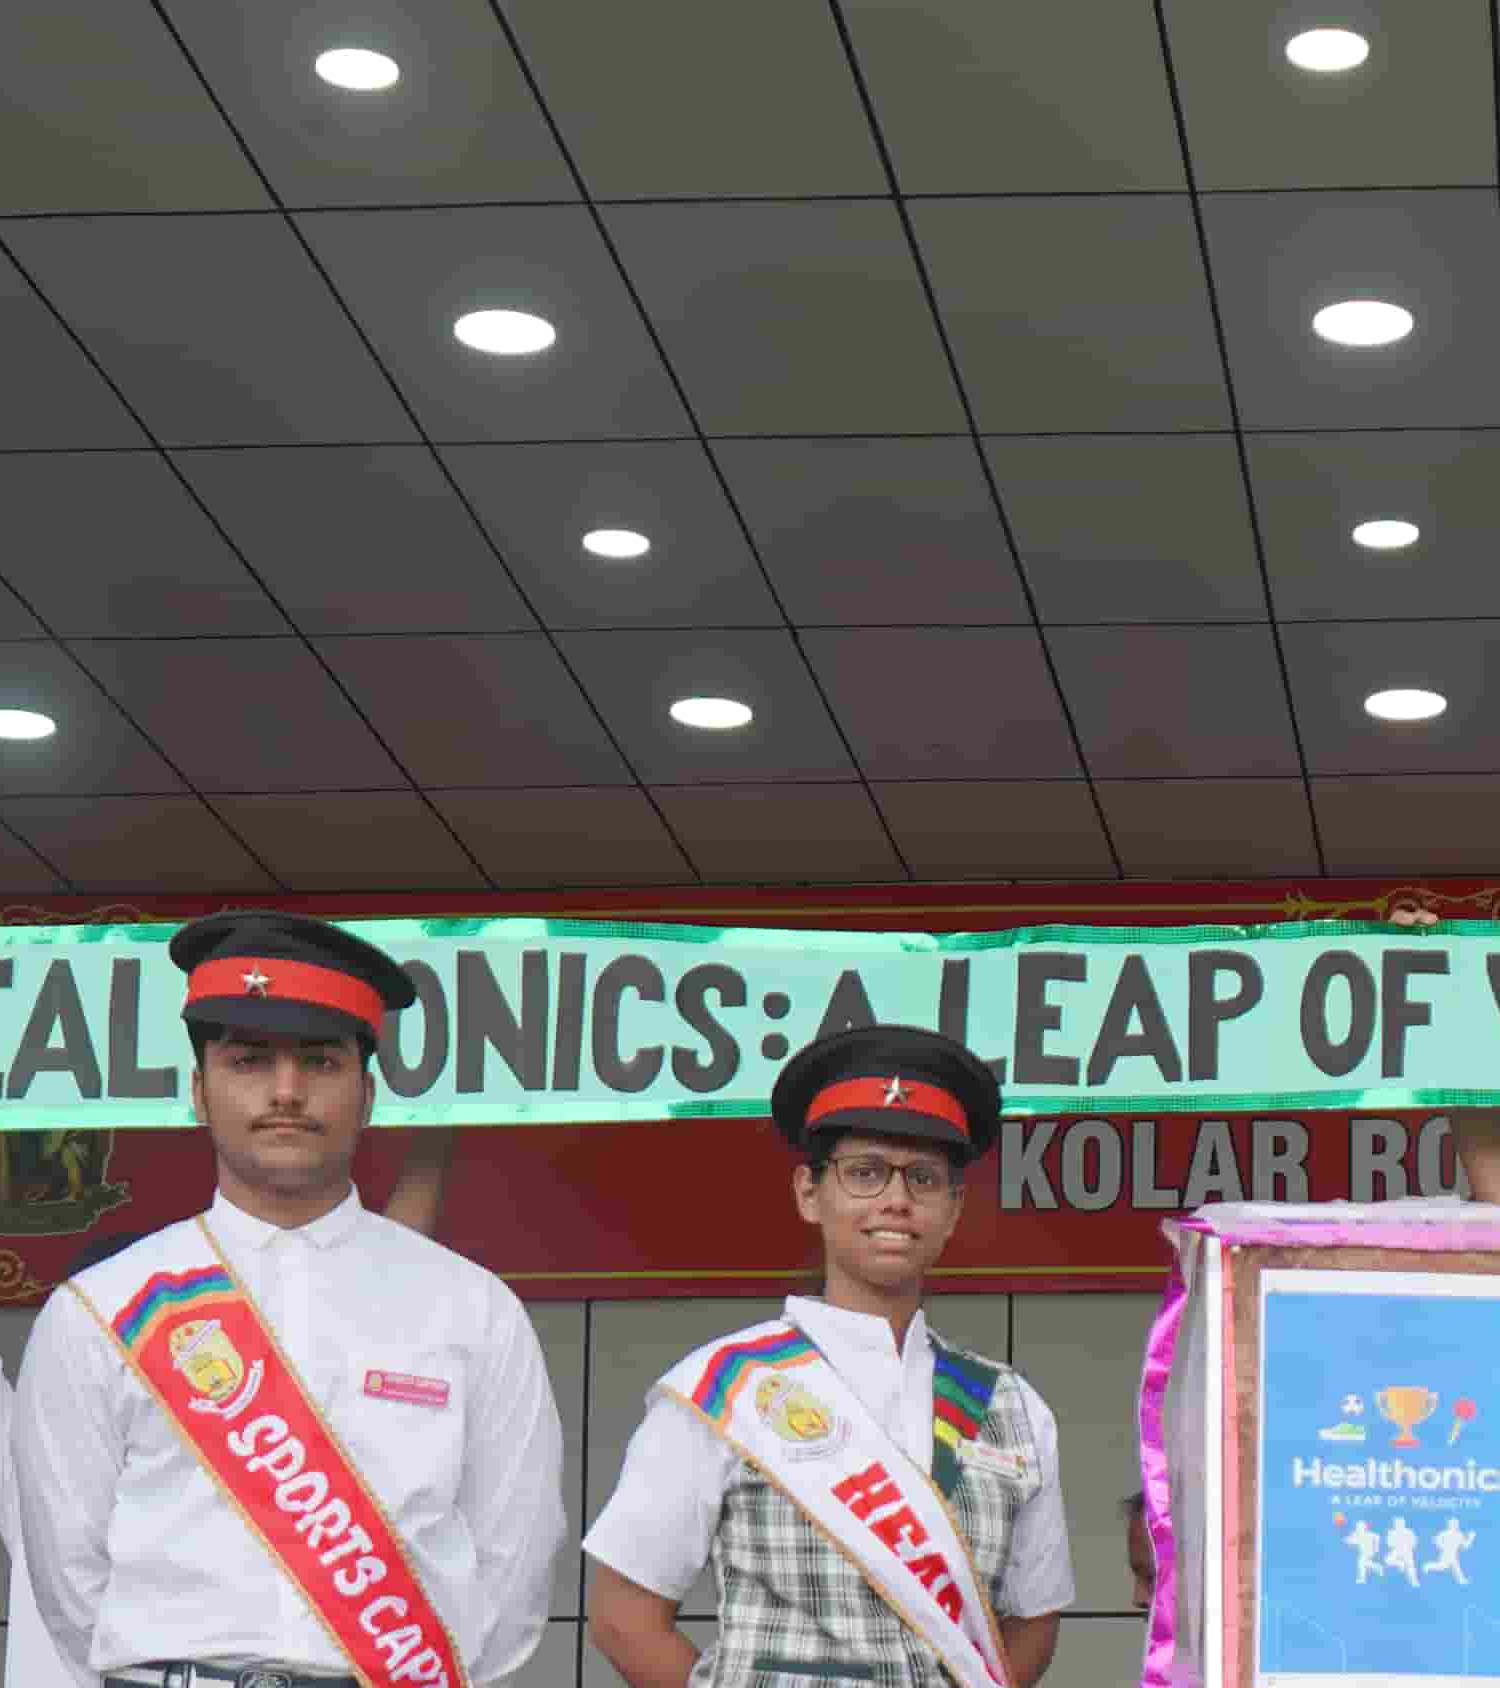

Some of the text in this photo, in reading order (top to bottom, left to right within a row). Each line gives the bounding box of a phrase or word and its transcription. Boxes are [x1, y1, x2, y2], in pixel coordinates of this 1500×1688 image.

[939, 950, 1264, 1087] LEAP
[1298, 948, 1450, 1080] OF
[999, 1115, 1311, 1212] KOLAR
[227, 1412, 387, 1596] SPORTS
